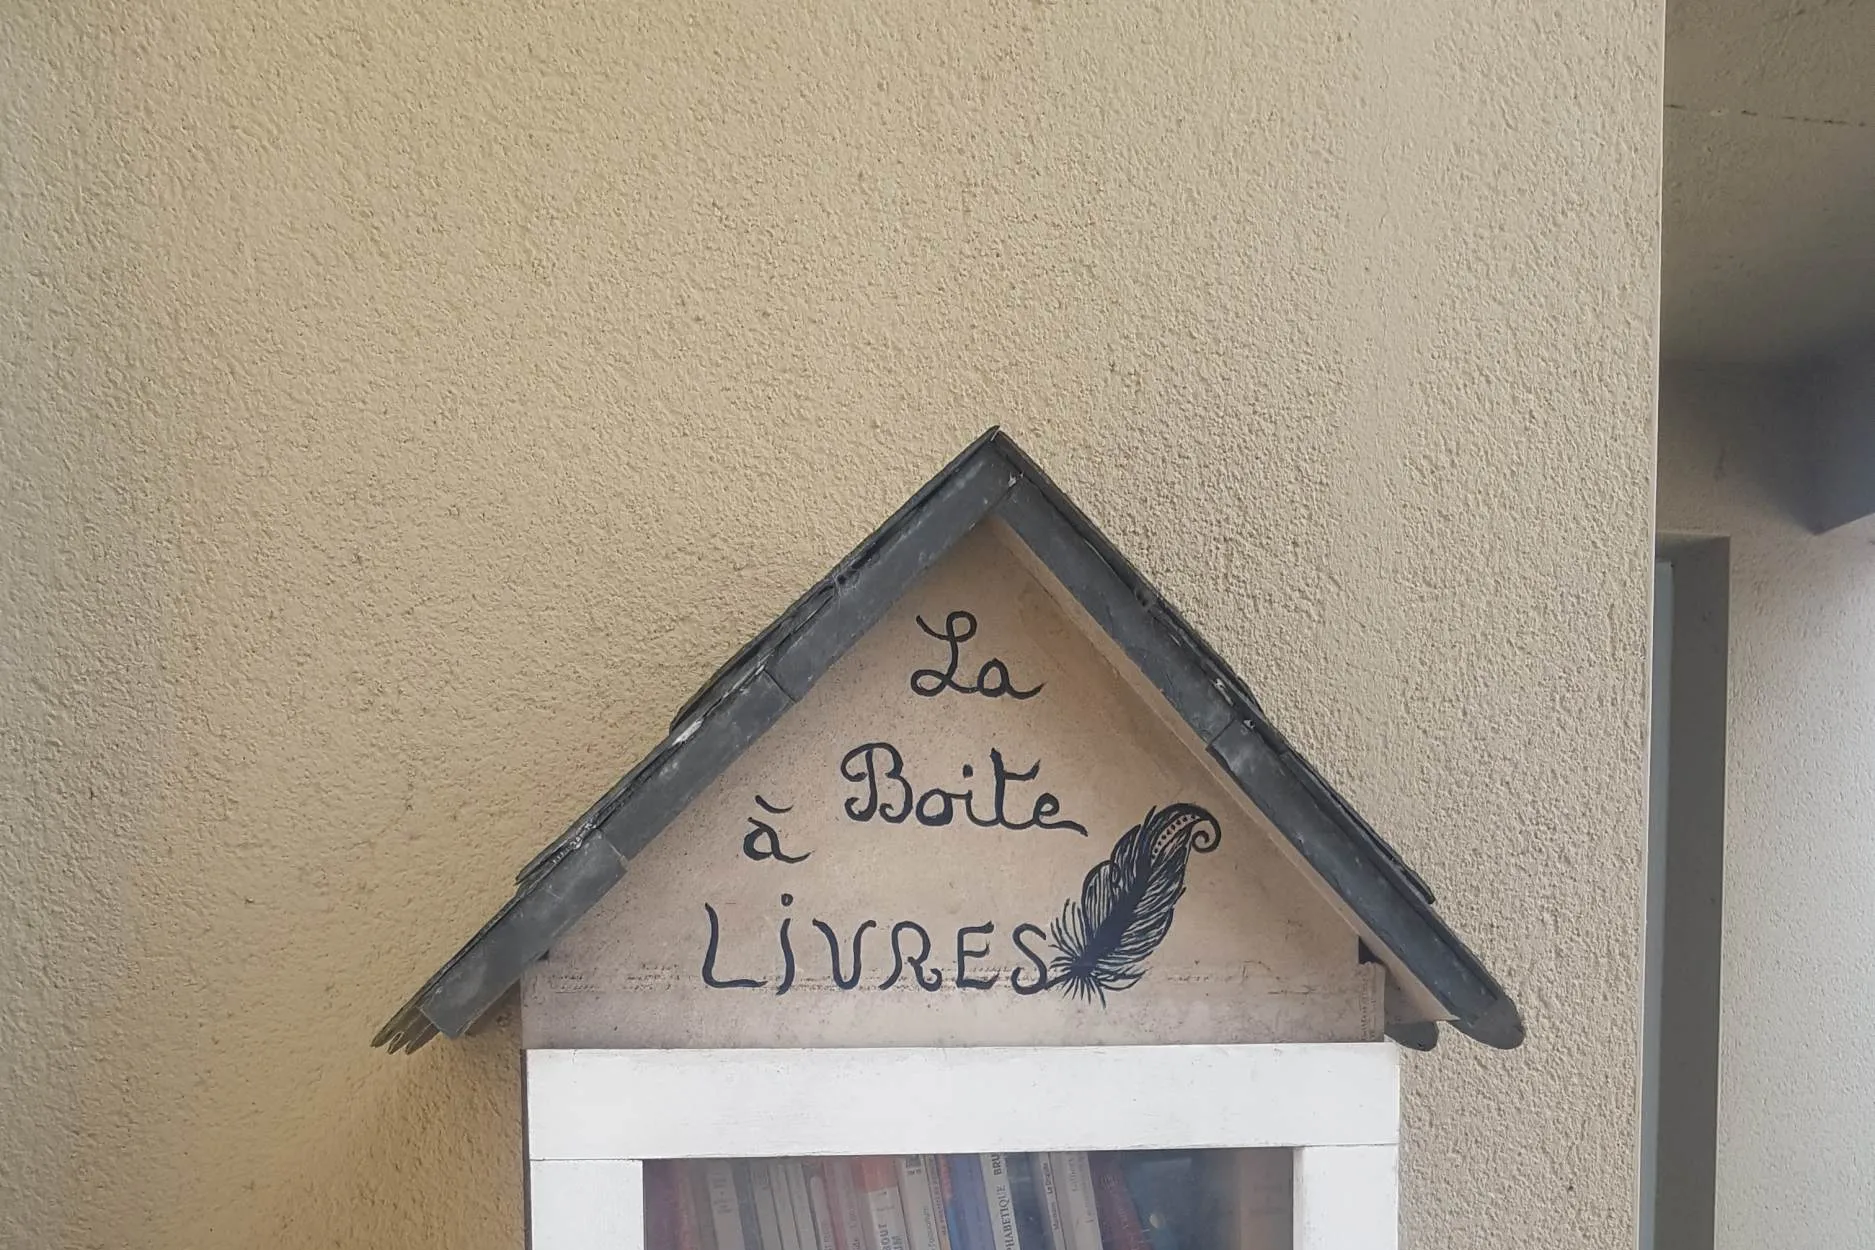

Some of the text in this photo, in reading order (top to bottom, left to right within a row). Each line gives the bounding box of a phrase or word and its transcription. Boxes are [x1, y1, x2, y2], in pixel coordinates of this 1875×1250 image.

[911, 610, 1048, 700] La
[741, 795, 811, 864] à
[839, 741, 1089, 838] Boite
